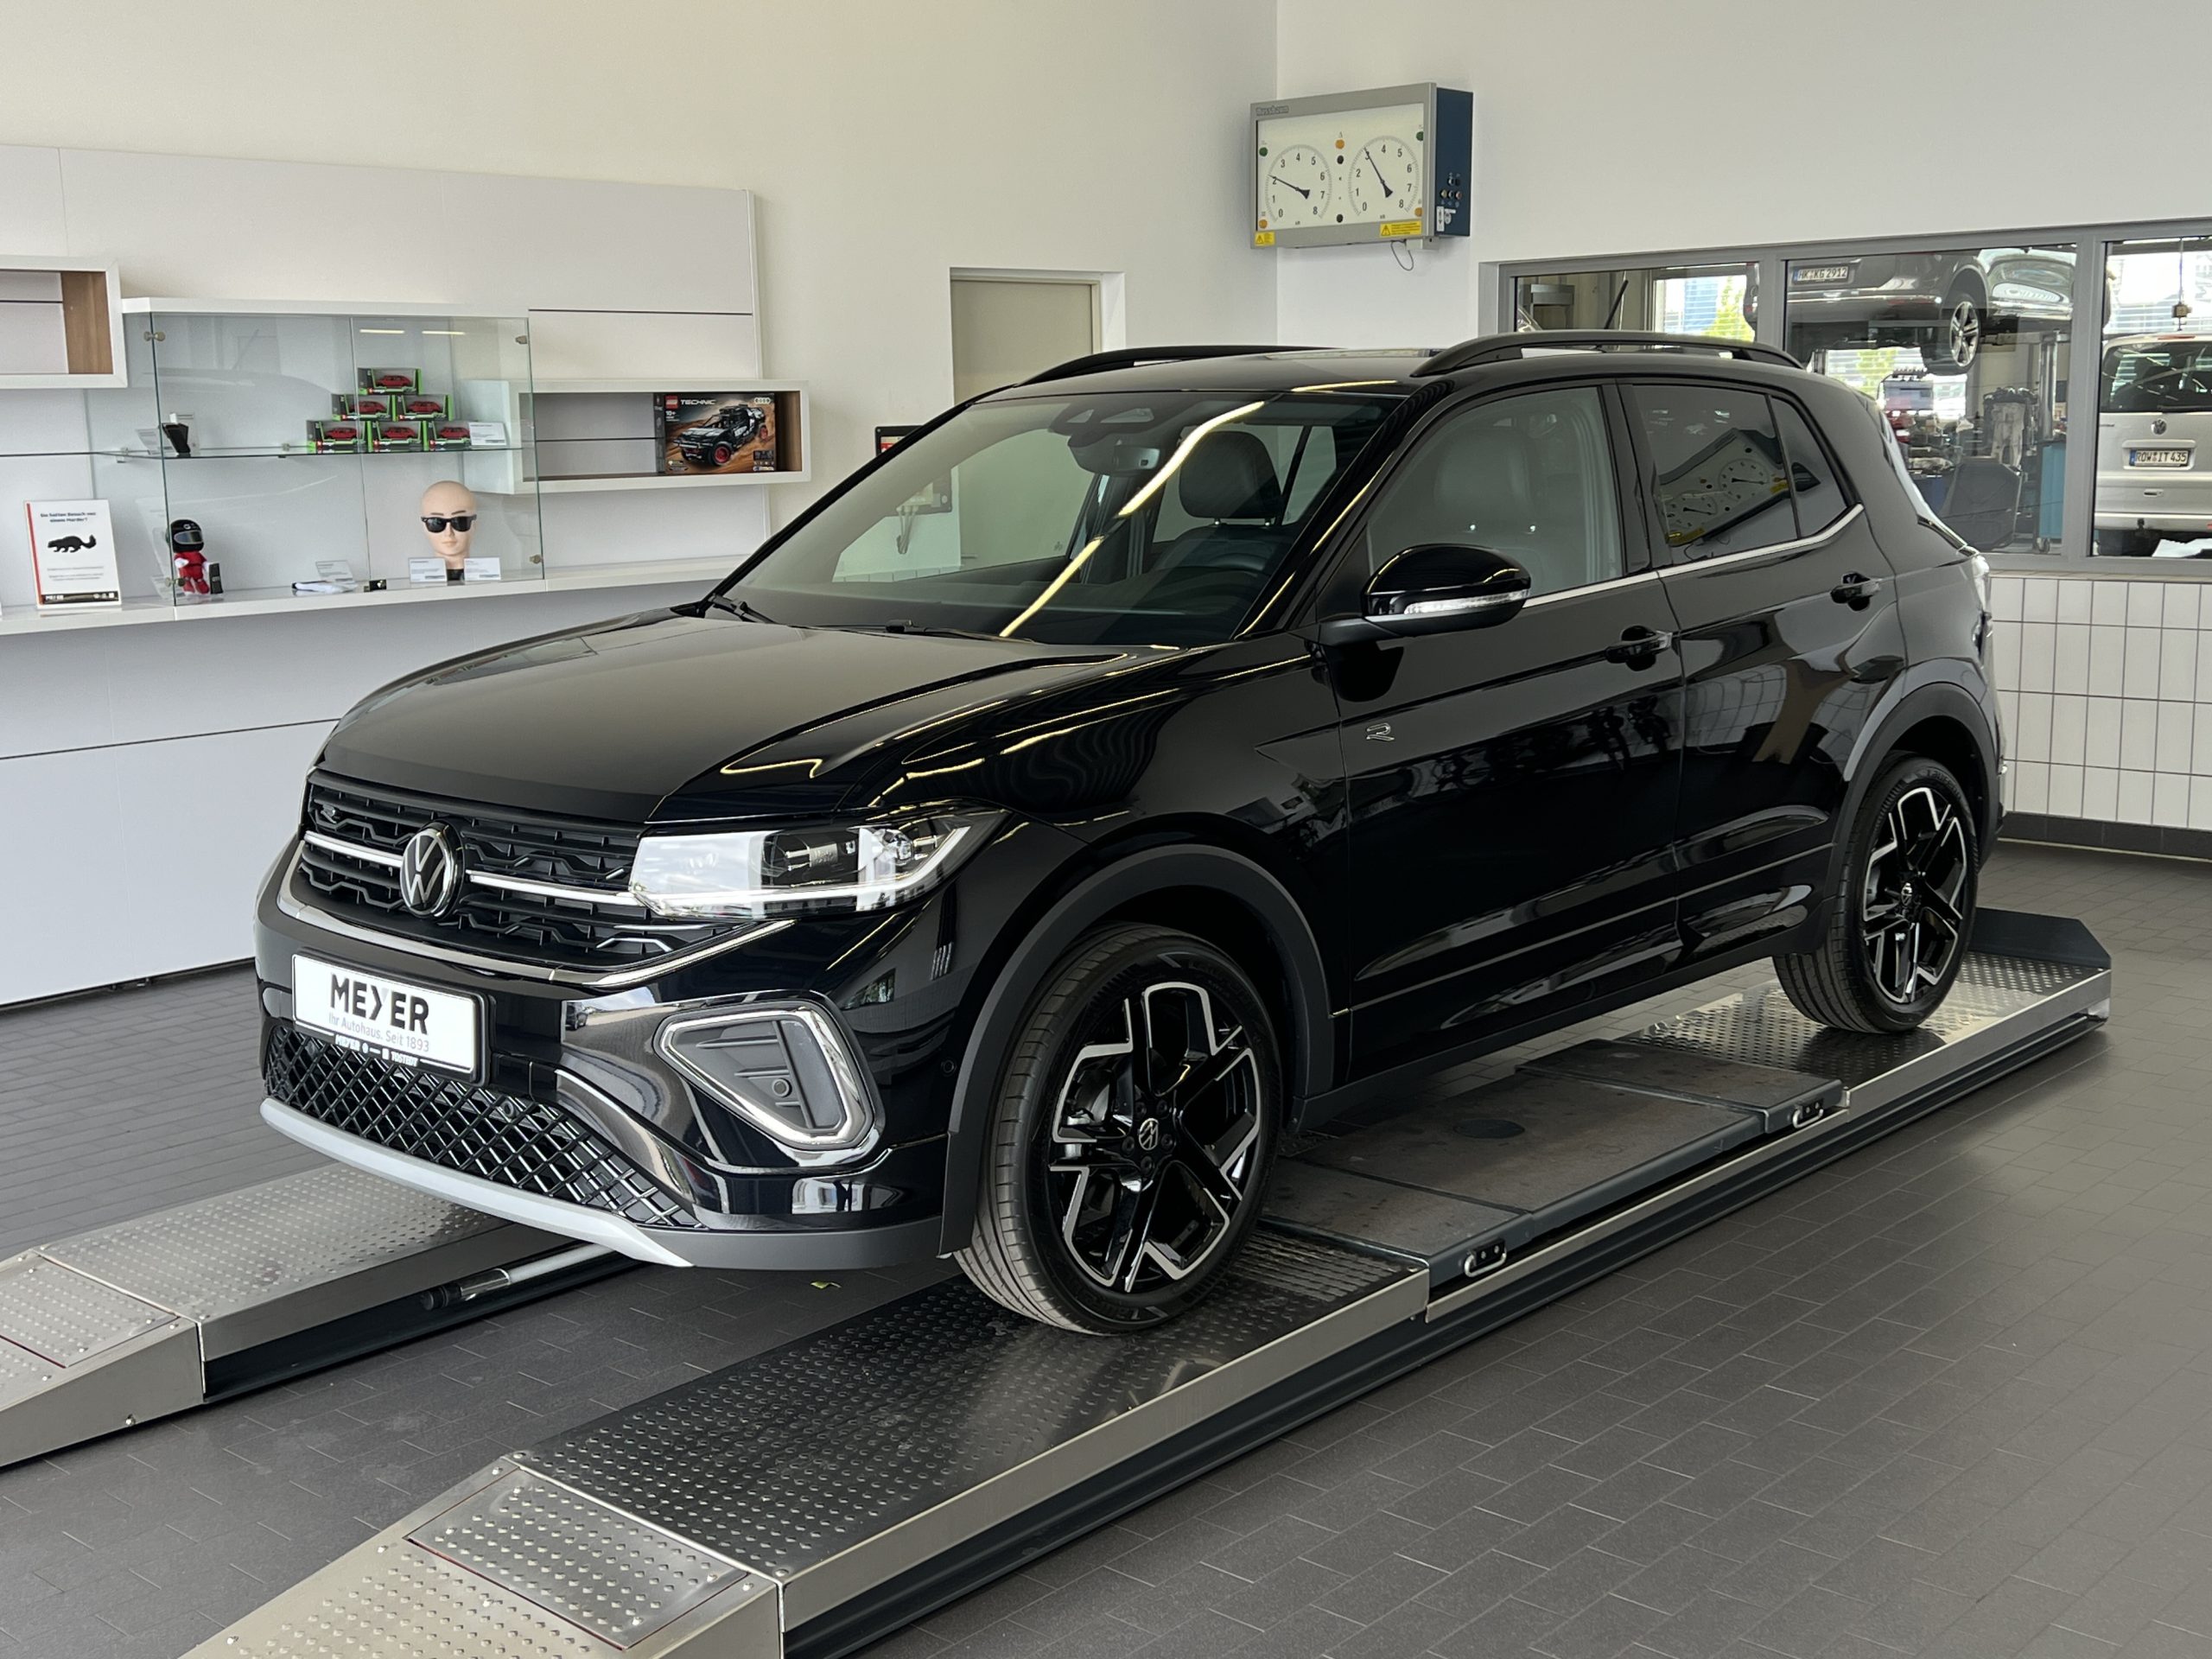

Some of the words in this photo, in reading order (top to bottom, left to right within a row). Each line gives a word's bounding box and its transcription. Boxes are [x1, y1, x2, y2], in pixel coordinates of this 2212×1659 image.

[2171, 452, 2187, 462] 435
[330, 974, 429, 1035] MEYER
[328, 1012, 340, 1026] Ihr
[341, 1018, 384, 1040] Autohaus.
[385, 1029, 404, 1046] Seit
[406, 1035, 429, 1052] 1893
